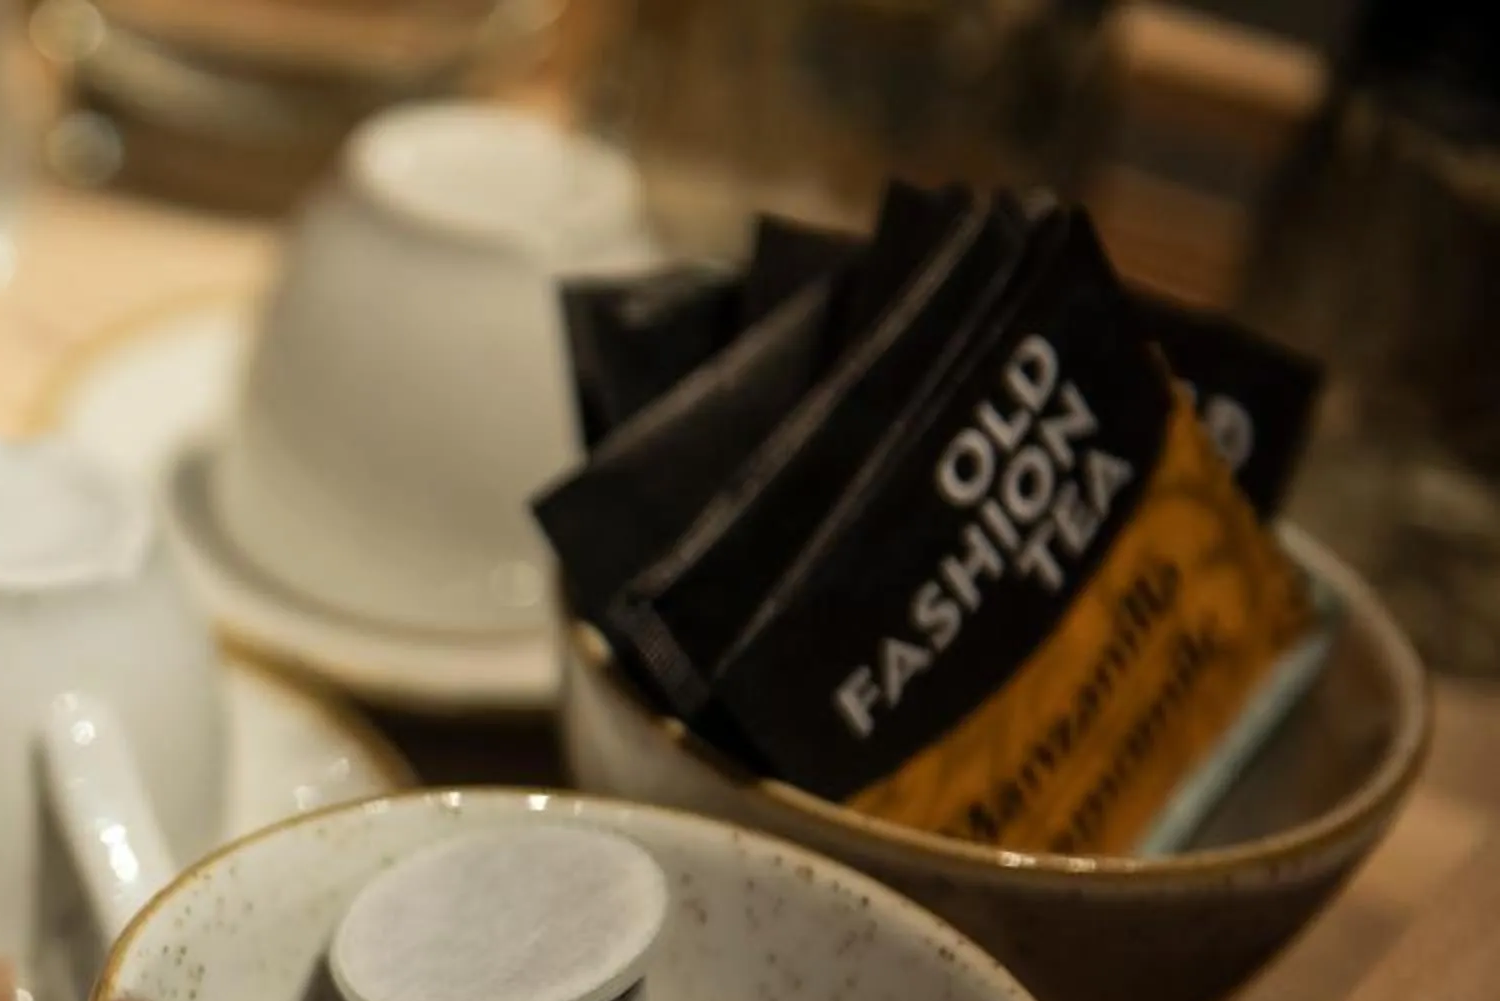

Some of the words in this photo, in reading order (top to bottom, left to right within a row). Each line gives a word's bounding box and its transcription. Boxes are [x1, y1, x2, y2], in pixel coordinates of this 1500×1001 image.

[935, 333, 1060, 506] OLD
[833, 379, 1100, 740] FASHION
[1014, 449, 1134, 592] TEA
